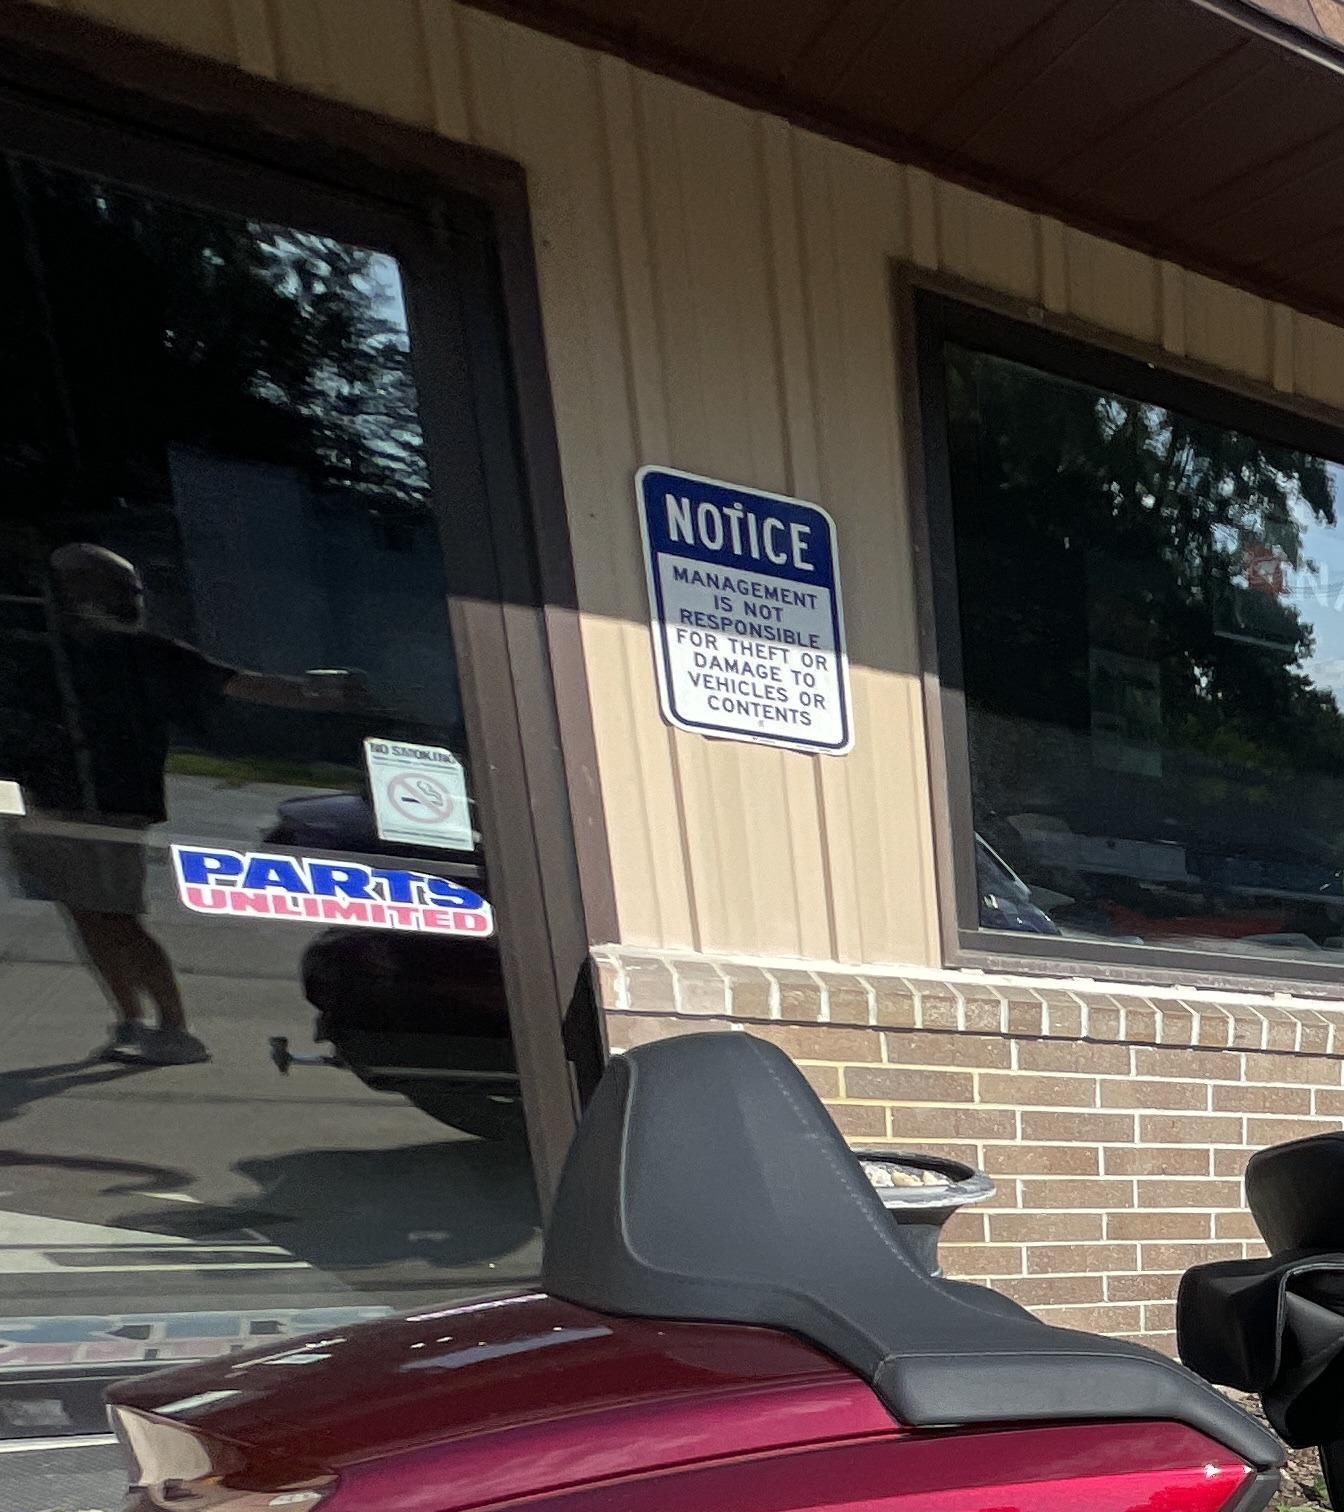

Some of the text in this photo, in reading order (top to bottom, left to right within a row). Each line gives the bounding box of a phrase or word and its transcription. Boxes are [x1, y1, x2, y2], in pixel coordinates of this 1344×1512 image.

[665, 493, 815, 571] NOTICE
[672, 565, 818, 610] MANAGEMENT
[714, 594, 784, 622] IS NOT
[676, 628, 828, 671] FOR THEFT OR
[680, 607, 820, 650] RESPONSIBLE
[687, 671, 827, 710] VEHICLES OR
[694, 651, 816, 688] DAMAGE TO
[707, 694, 812, 726] CONTENTS
[370, 742, 389, 754] NO
[178, 849, 484, 910] PARTS
[186, 887, 489, 932] UNLIMITED
